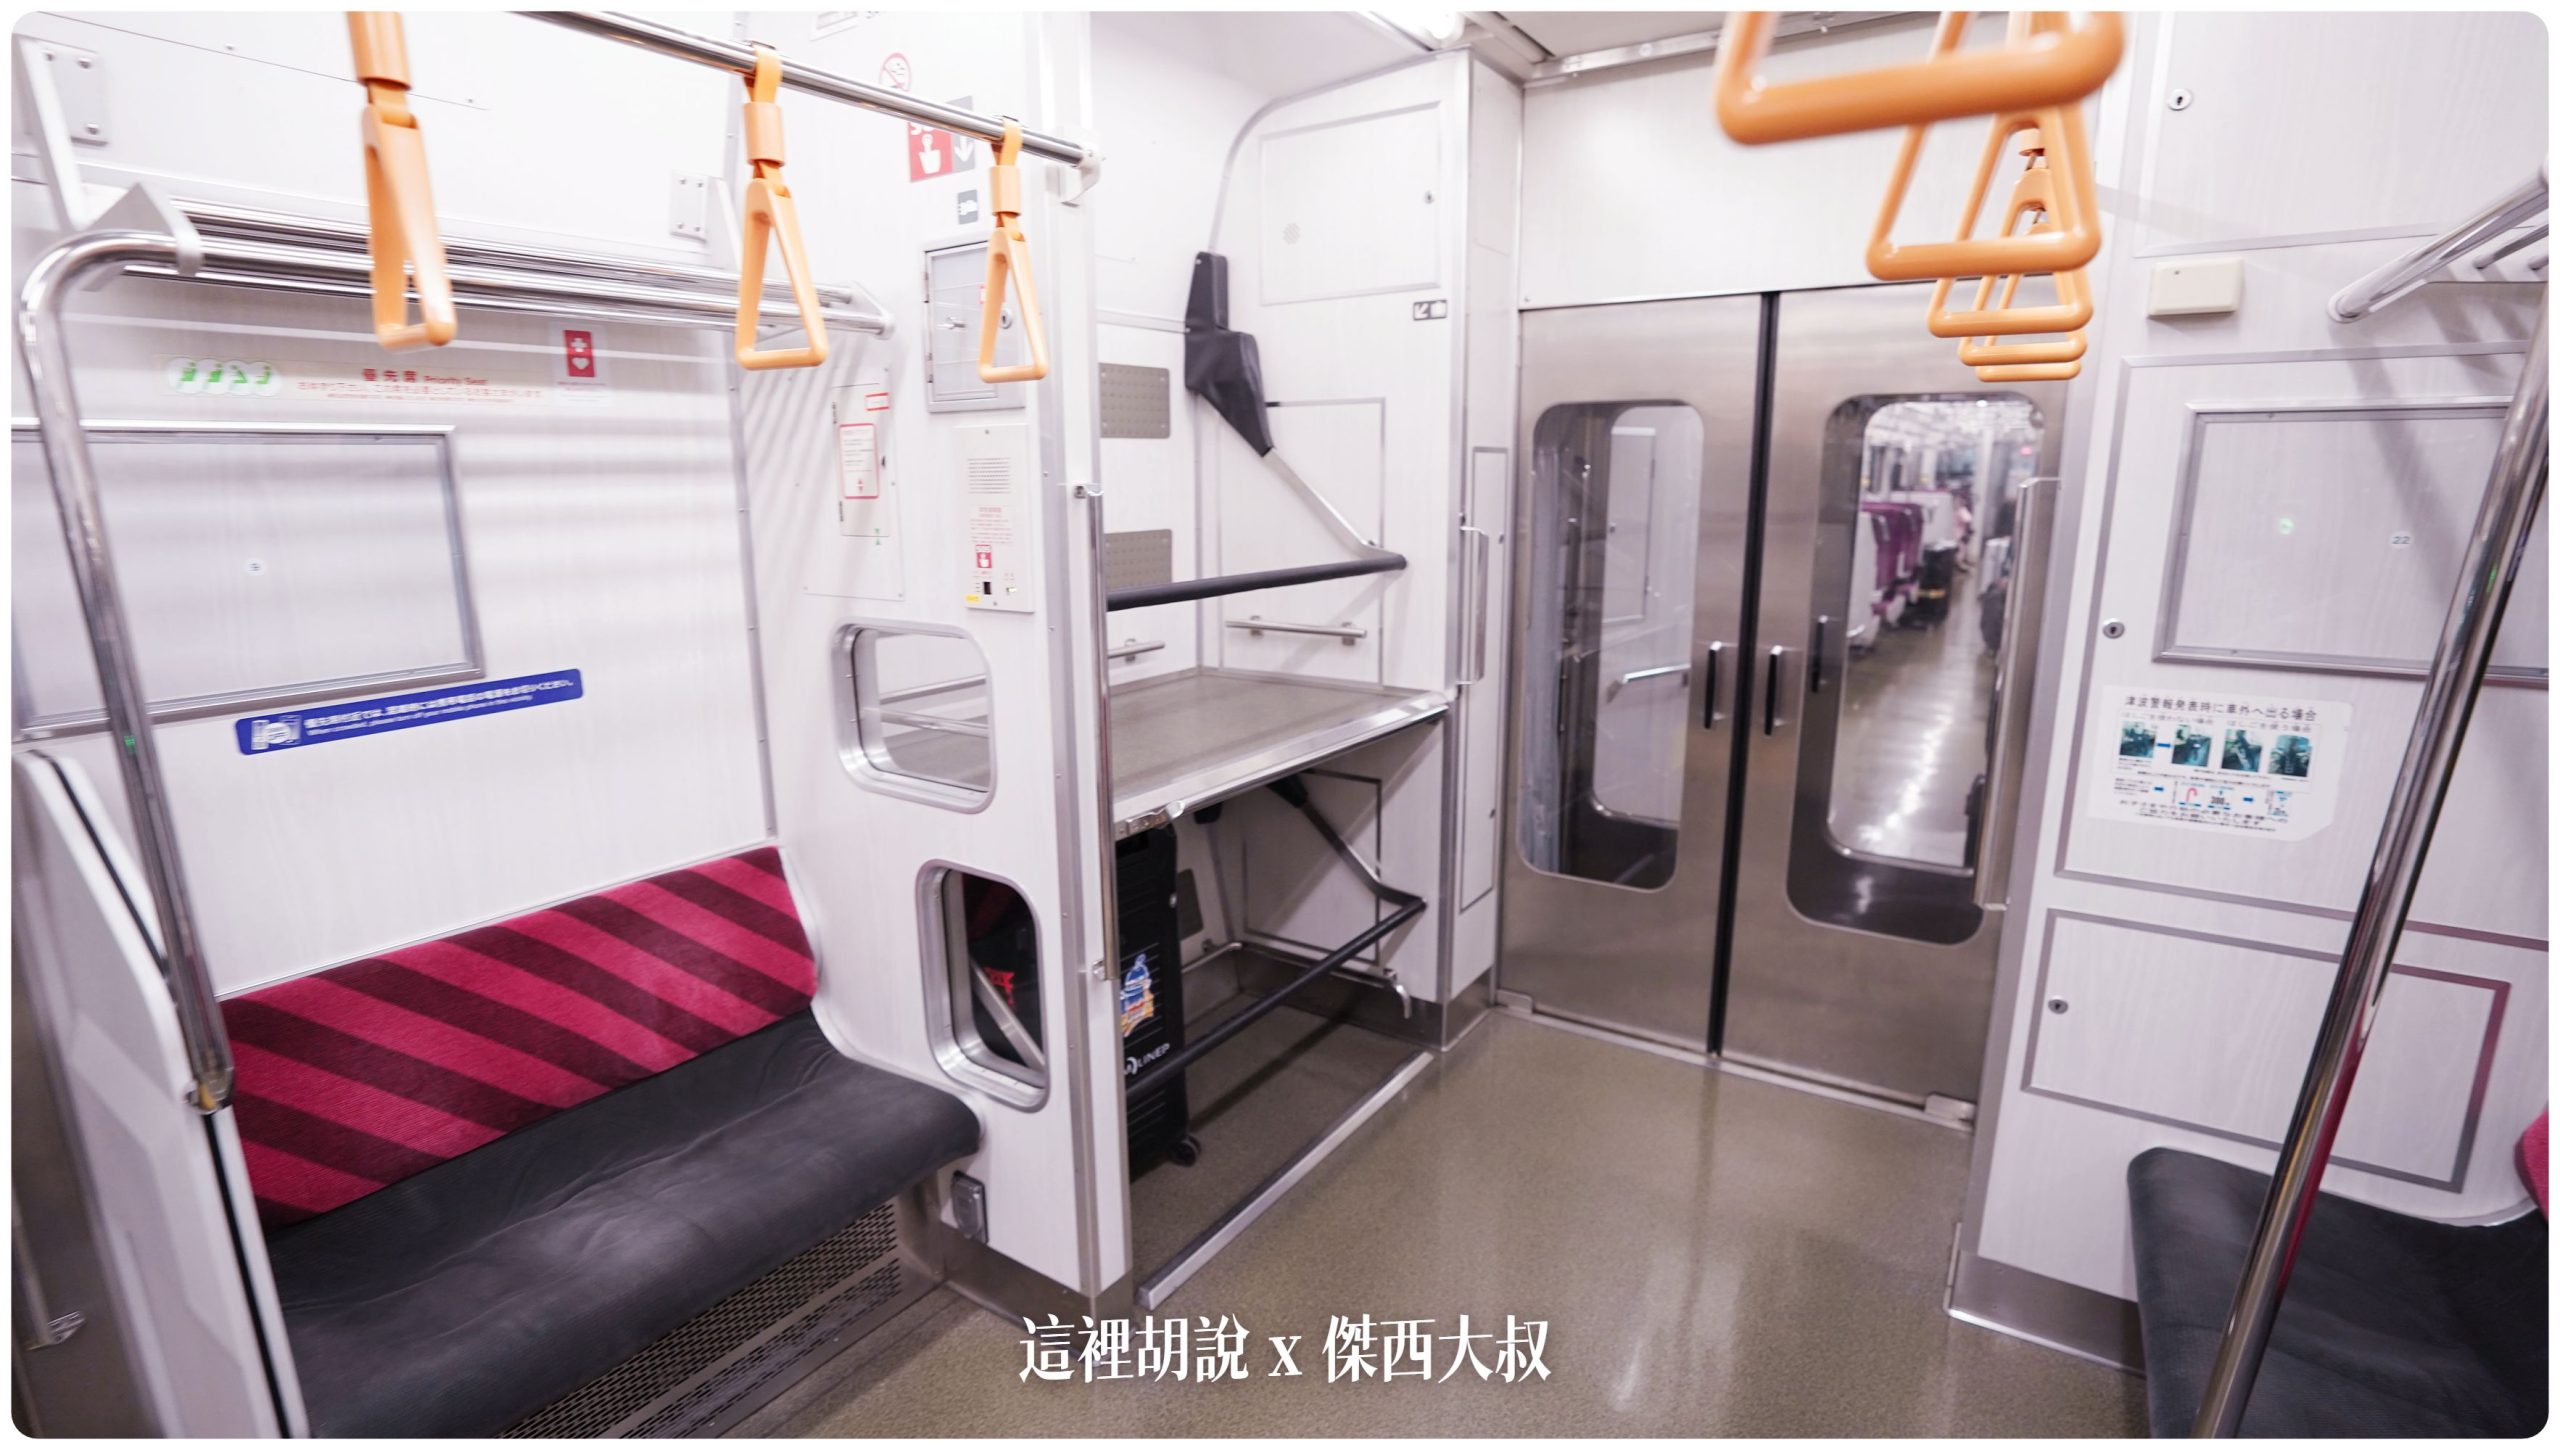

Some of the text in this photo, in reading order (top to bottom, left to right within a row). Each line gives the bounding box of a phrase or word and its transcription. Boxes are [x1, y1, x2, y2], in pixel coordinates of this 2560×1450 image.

[2392, 535, 2411, 545] 22
[2125, 696, 2317, 722] 津波警報発表時に車外へ出る場合
